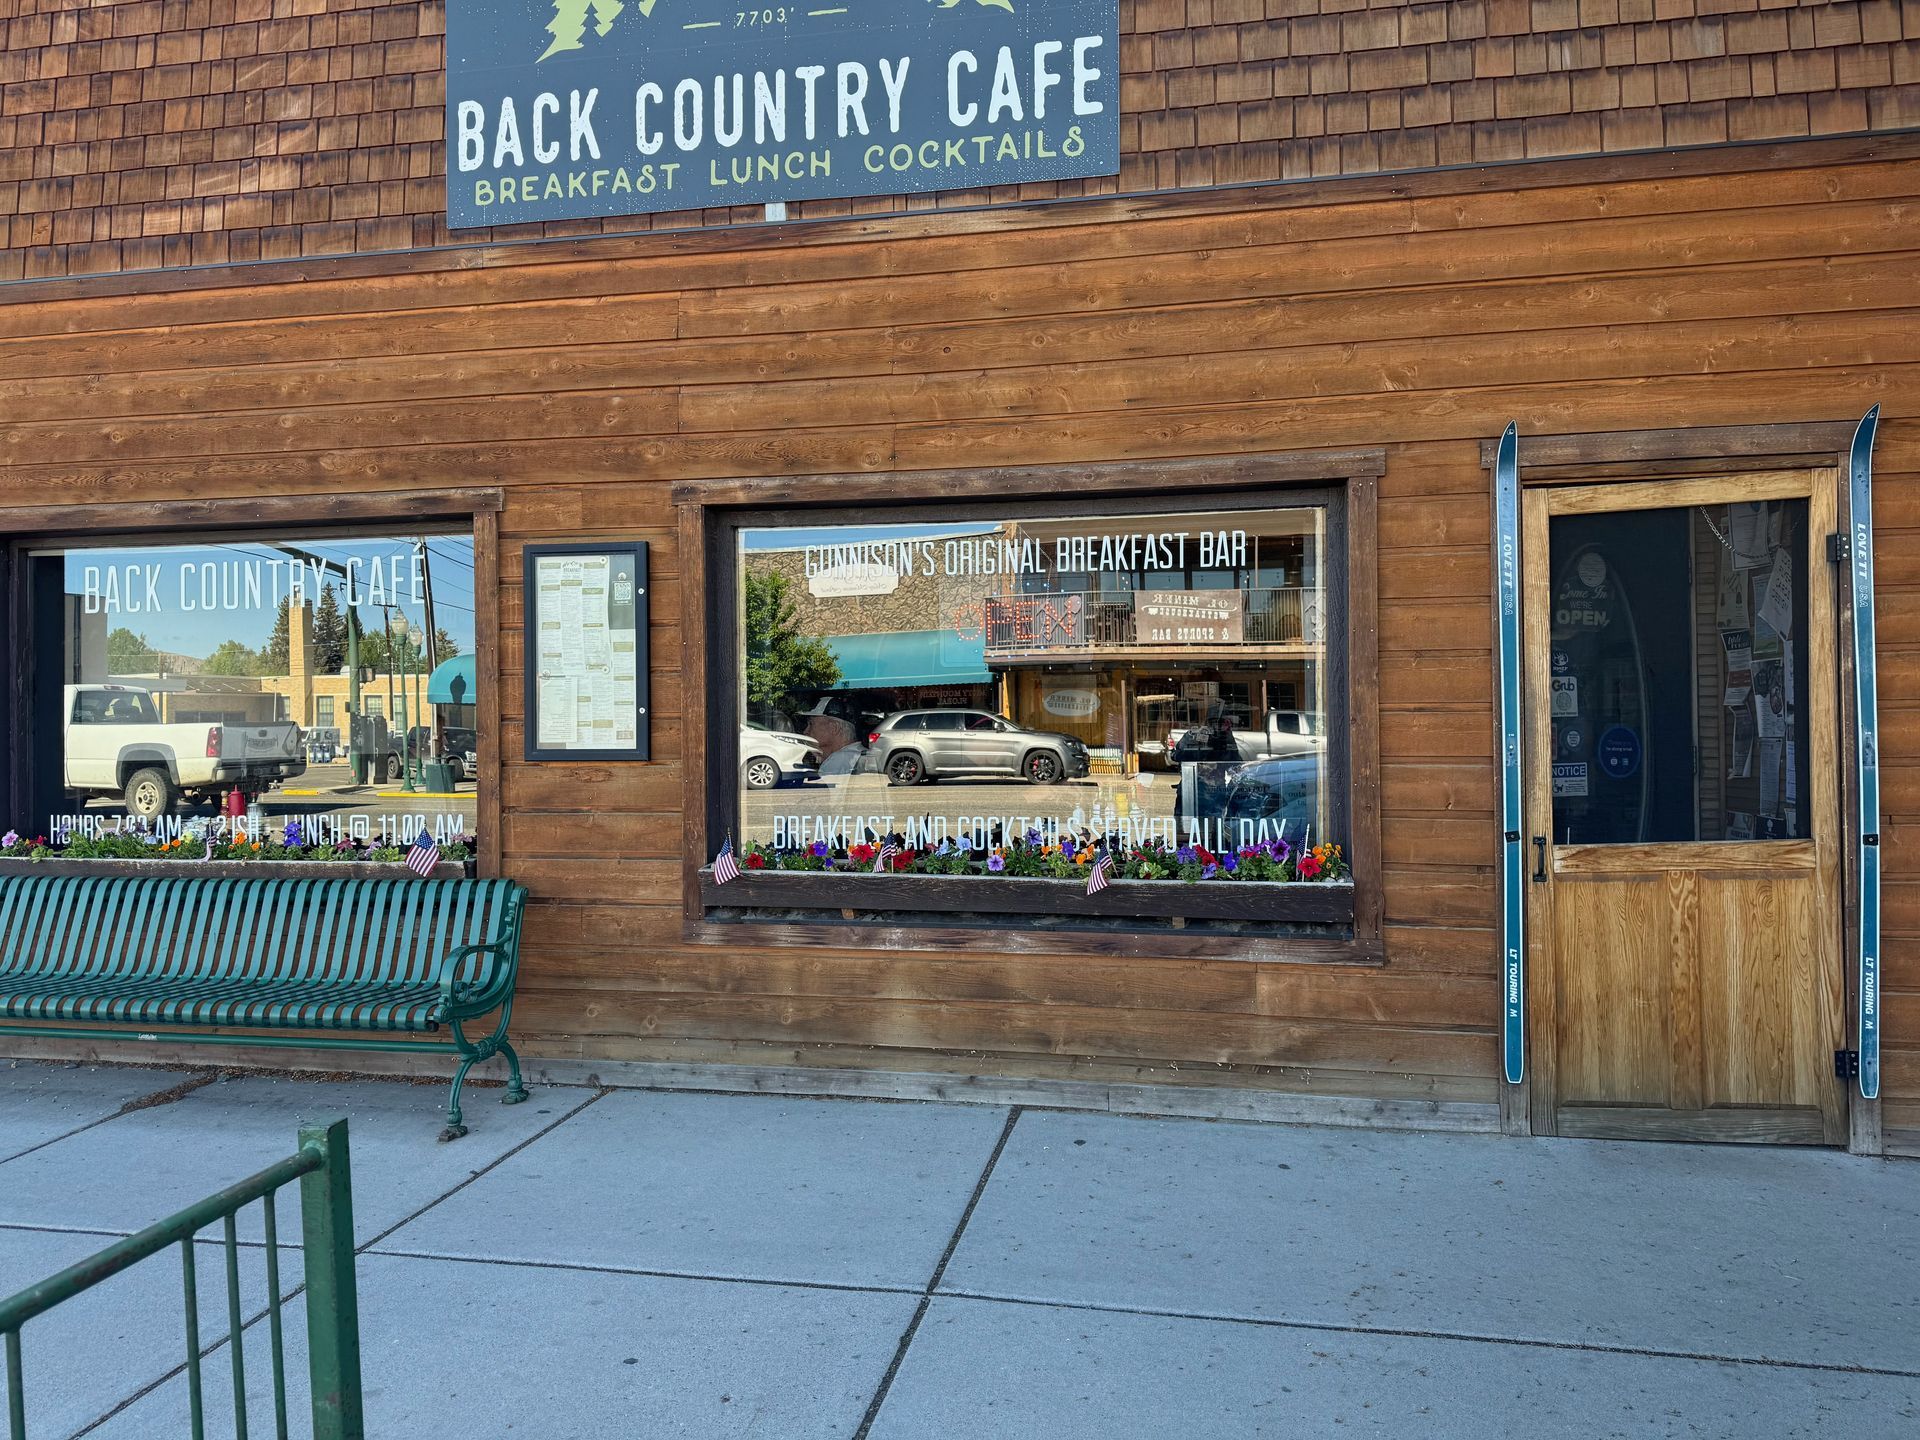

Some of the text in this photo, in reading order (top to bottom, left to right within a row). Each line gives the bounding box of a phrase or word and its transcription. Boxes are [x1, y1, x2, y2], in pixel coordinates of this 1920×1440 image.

[457, 35, 1104, 173] BACK COUNTRY CAFE
[474, 126, 1085, 207] BREAKFAST LUNCH COCKTAILS
[84, 542, 425, 615] BACK COUNTRY CAFÉ
[804, 529, 1247, 578] GUNNISON'S ORIGINAL BREAKFAST BAR
[1503, 534, 1514, 616] LOVETT USA
[1857, 523, 1869, 608] LOVETT USA
[955, 600, 1074, 641] OPEN
[1556, 609, 1607, 626] OPEN
[1552, 765, 1586, 777] NOTICE
[50, 814, 105, 845] HOURS
[111, 814, 147, 839] 700
[156, 814, 182, 845] AM
[349, 814, 370, 842] @
[377, 814, 426, 846] 11:00
[434, 813, 464, 846] AM
[773, 815, 1287, 854] BREAKFAST AND COCKTAILS SERVED ALL DAY
[1509, 948, 1518, 1018] LT TOURING M
[1865, 956, 1874, 1030] LT TOURING M
